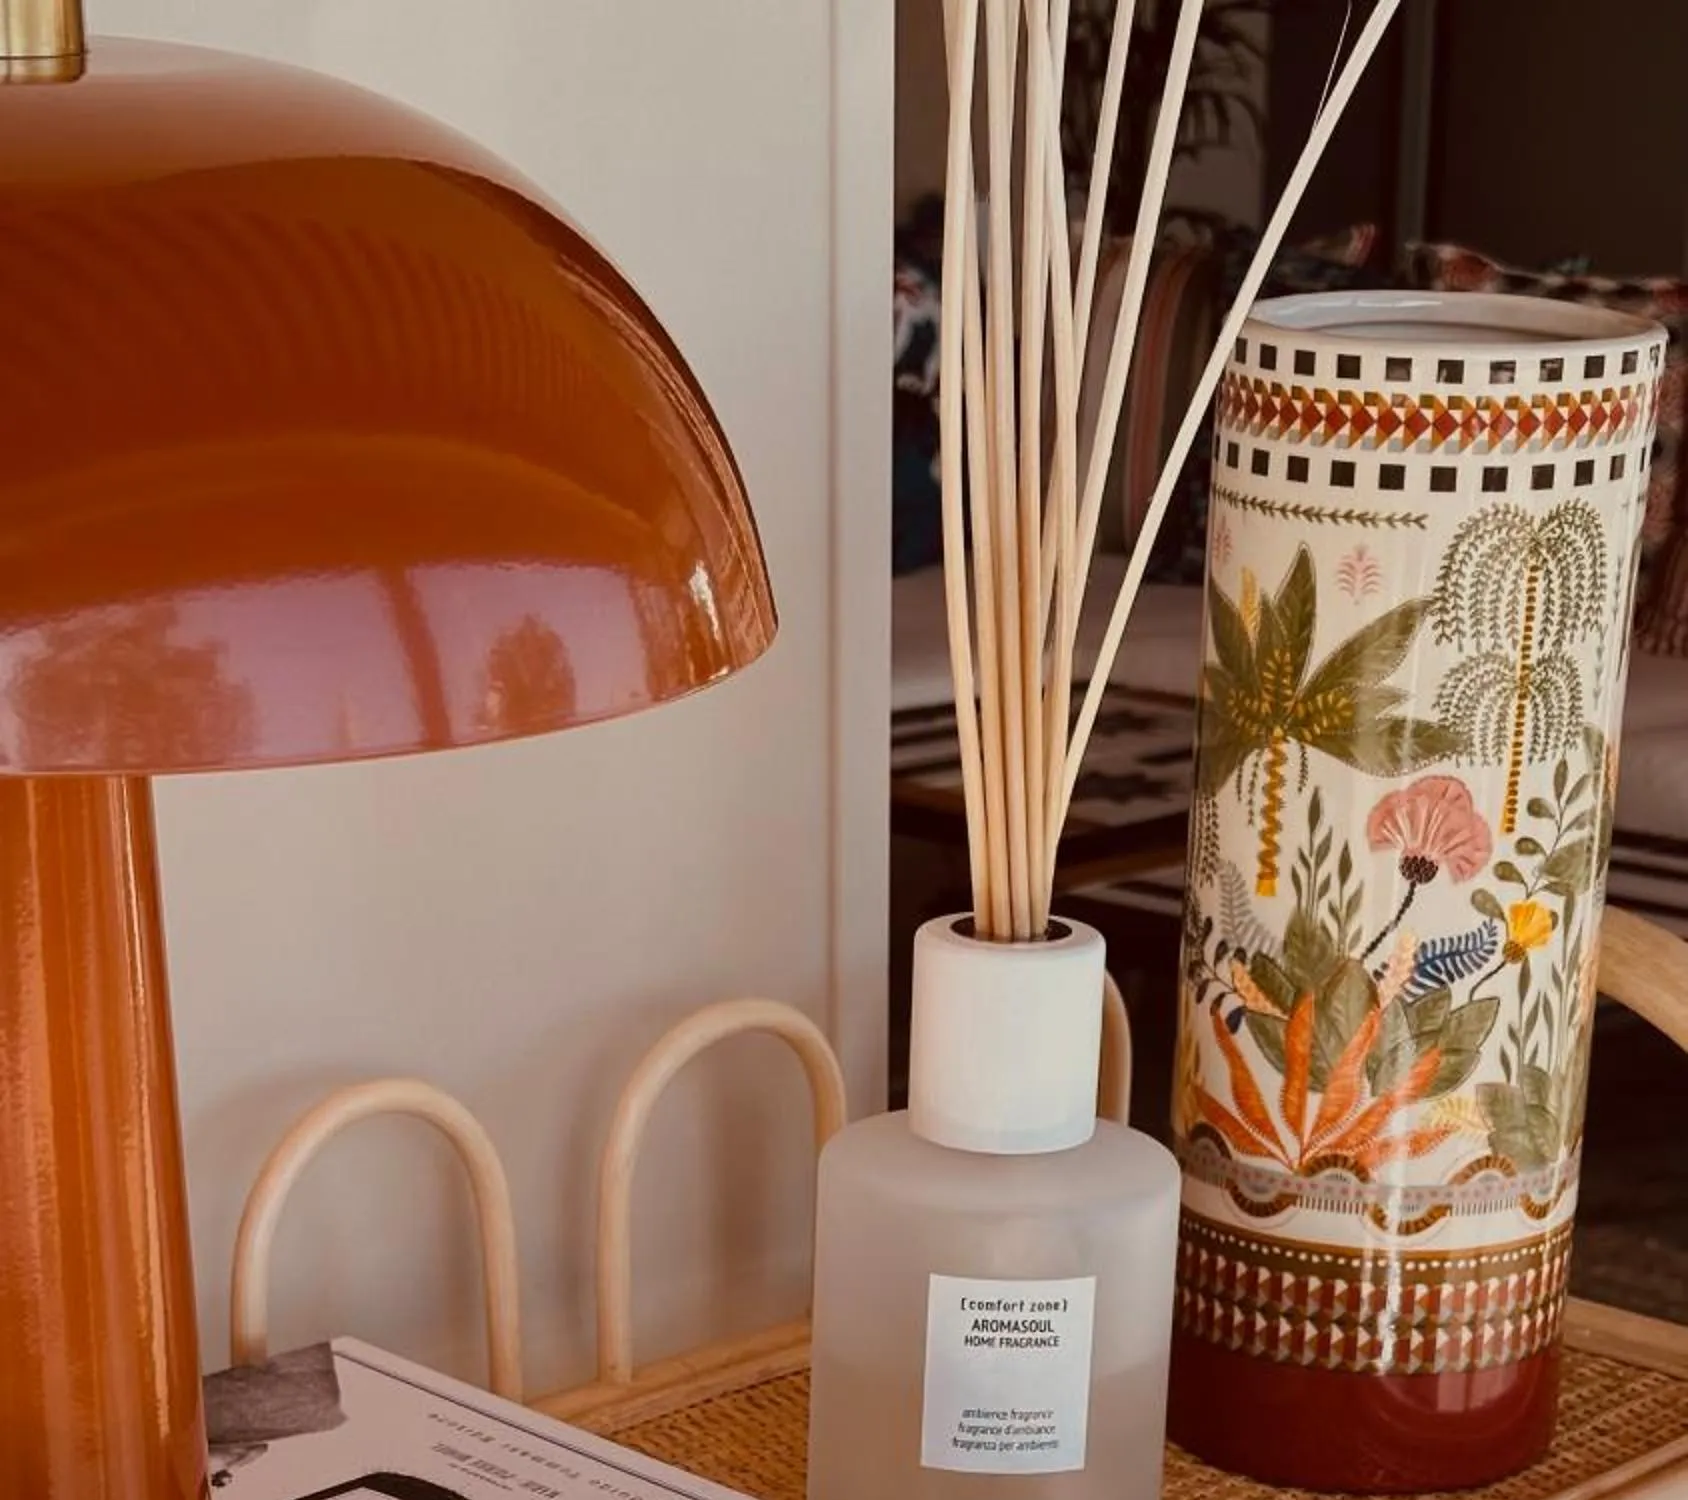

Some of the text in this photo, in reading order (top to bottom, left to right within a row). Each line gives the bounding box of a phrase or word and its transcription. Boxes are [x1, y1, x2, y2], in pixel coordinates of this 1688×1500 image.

[971, 1318, 1055, 1333] AROMASOUL
[964, 1335, 1061, 1349] HOME FRAGRANCE
